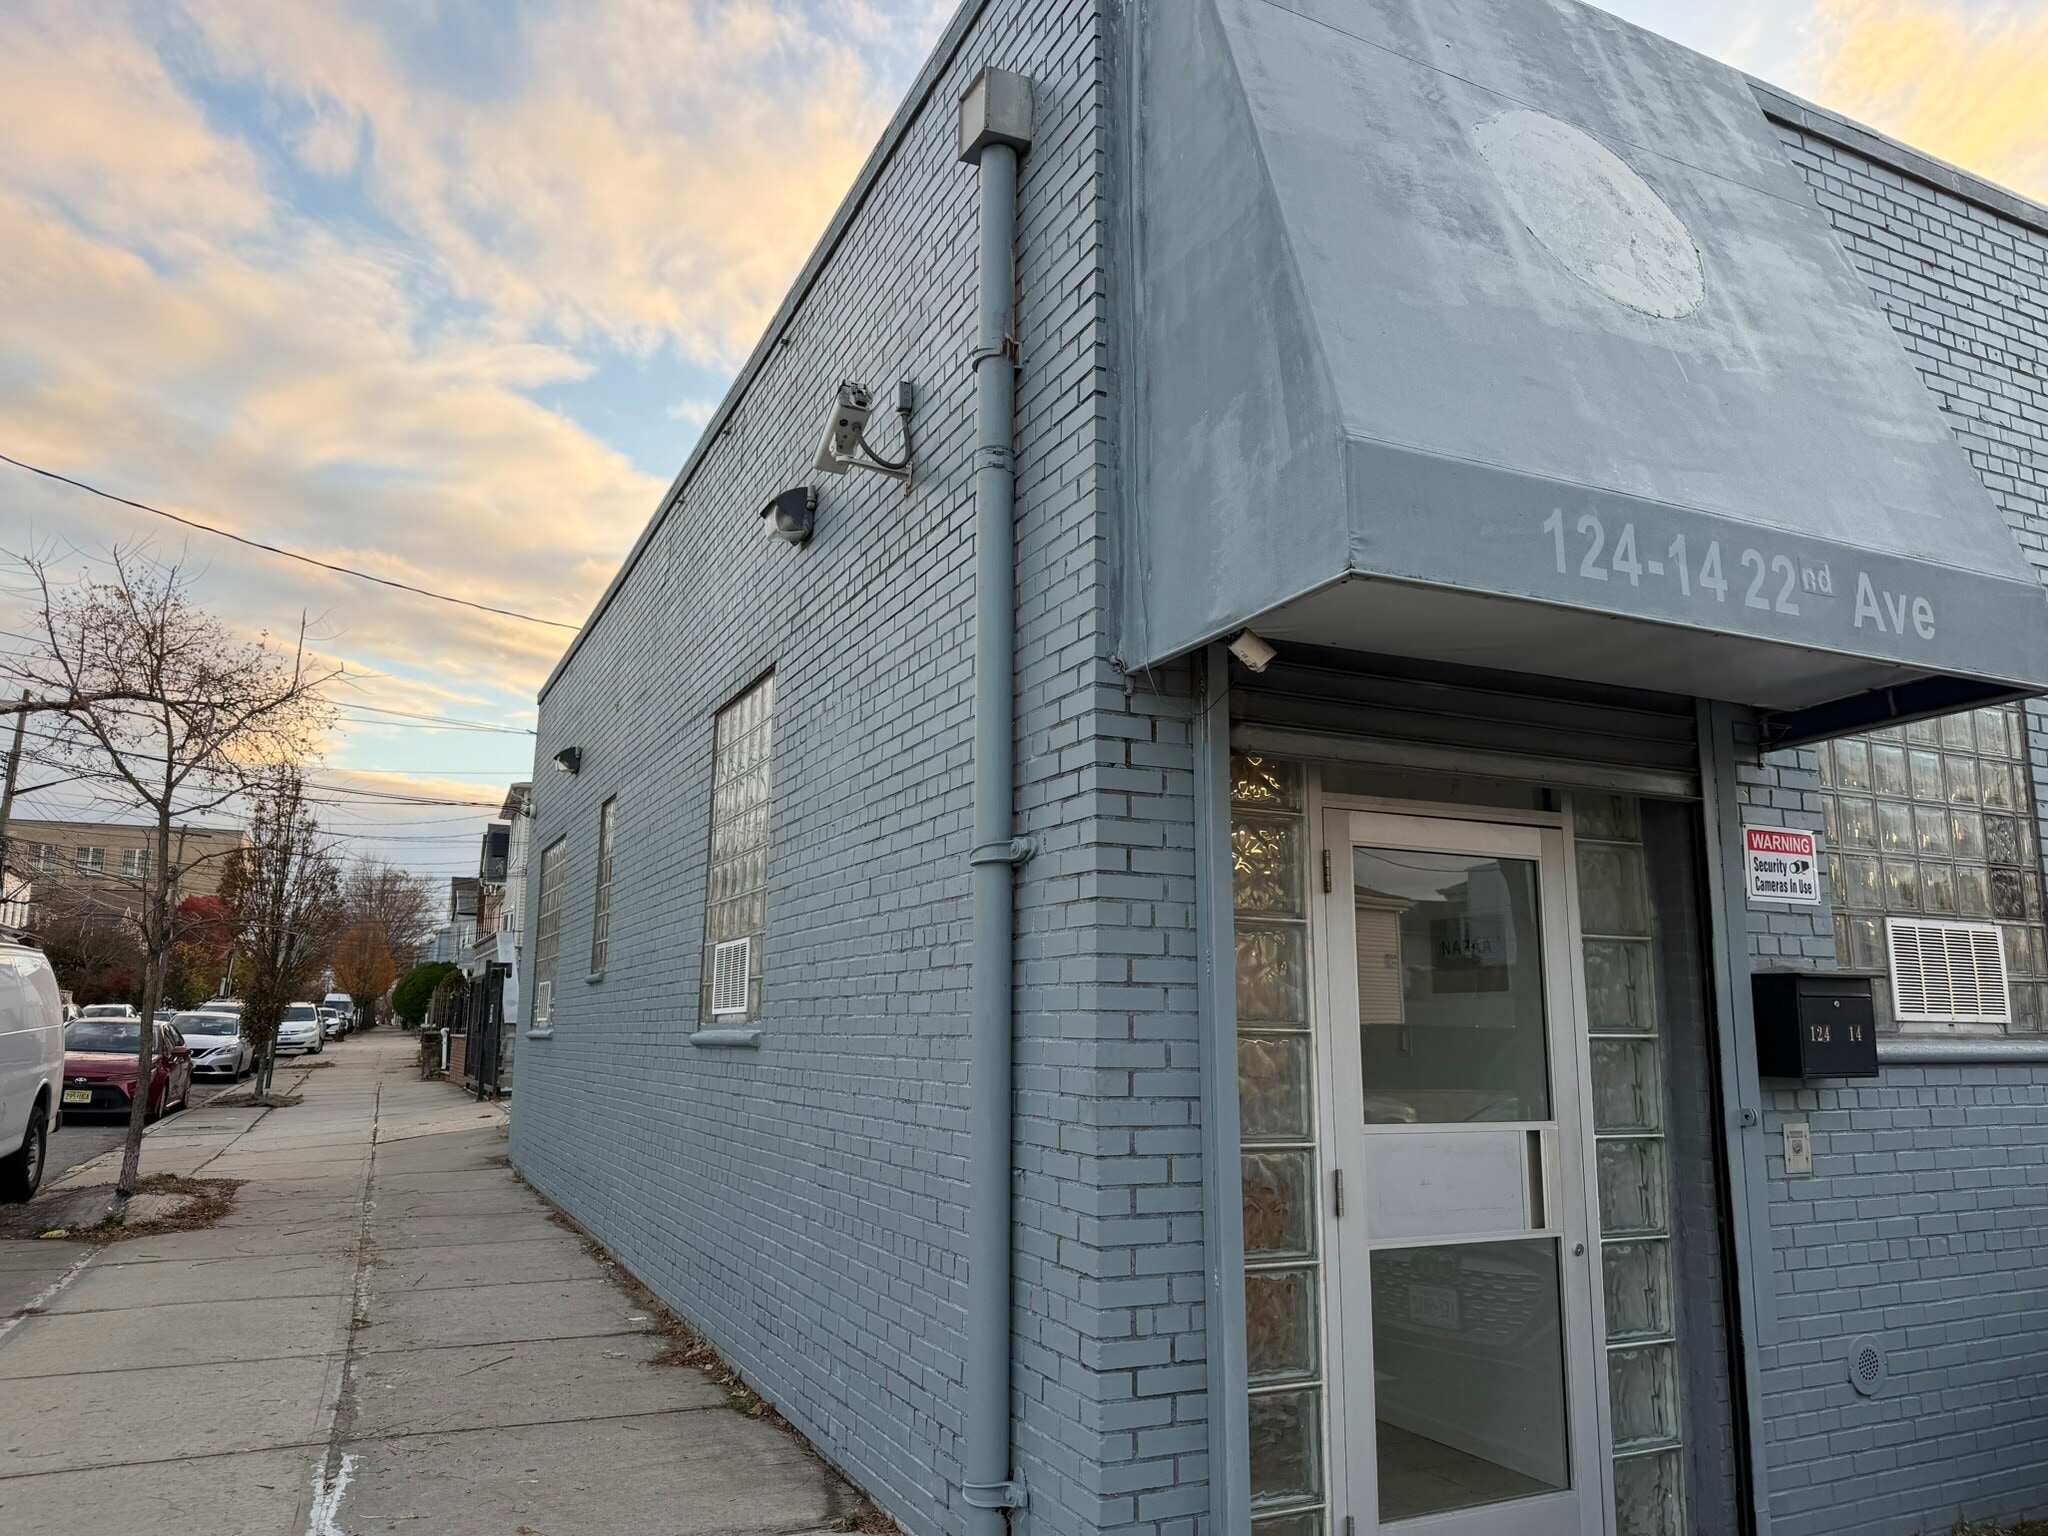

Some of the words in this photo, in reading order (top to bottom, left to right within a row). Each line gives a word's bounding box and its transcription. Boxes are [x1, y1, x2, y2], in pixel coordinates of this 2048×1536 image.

[1543, 507, 1728, 602] 124-14
[1740, 548, 1832, 616] 22nd
[1853, 571, 1936, 640] Ave
[1751, 833, 1810, 854] WARNING
[1753, 856, 1788, 877] Security
[1755, 876, 1788, 893] Cameras
[1790, 878, 1798, 893] In
[1799, 879, 1812, 894] Use
[1810, 1025, 1831, 1042] 124
[1849, 1025, 1863, 1042] 14
